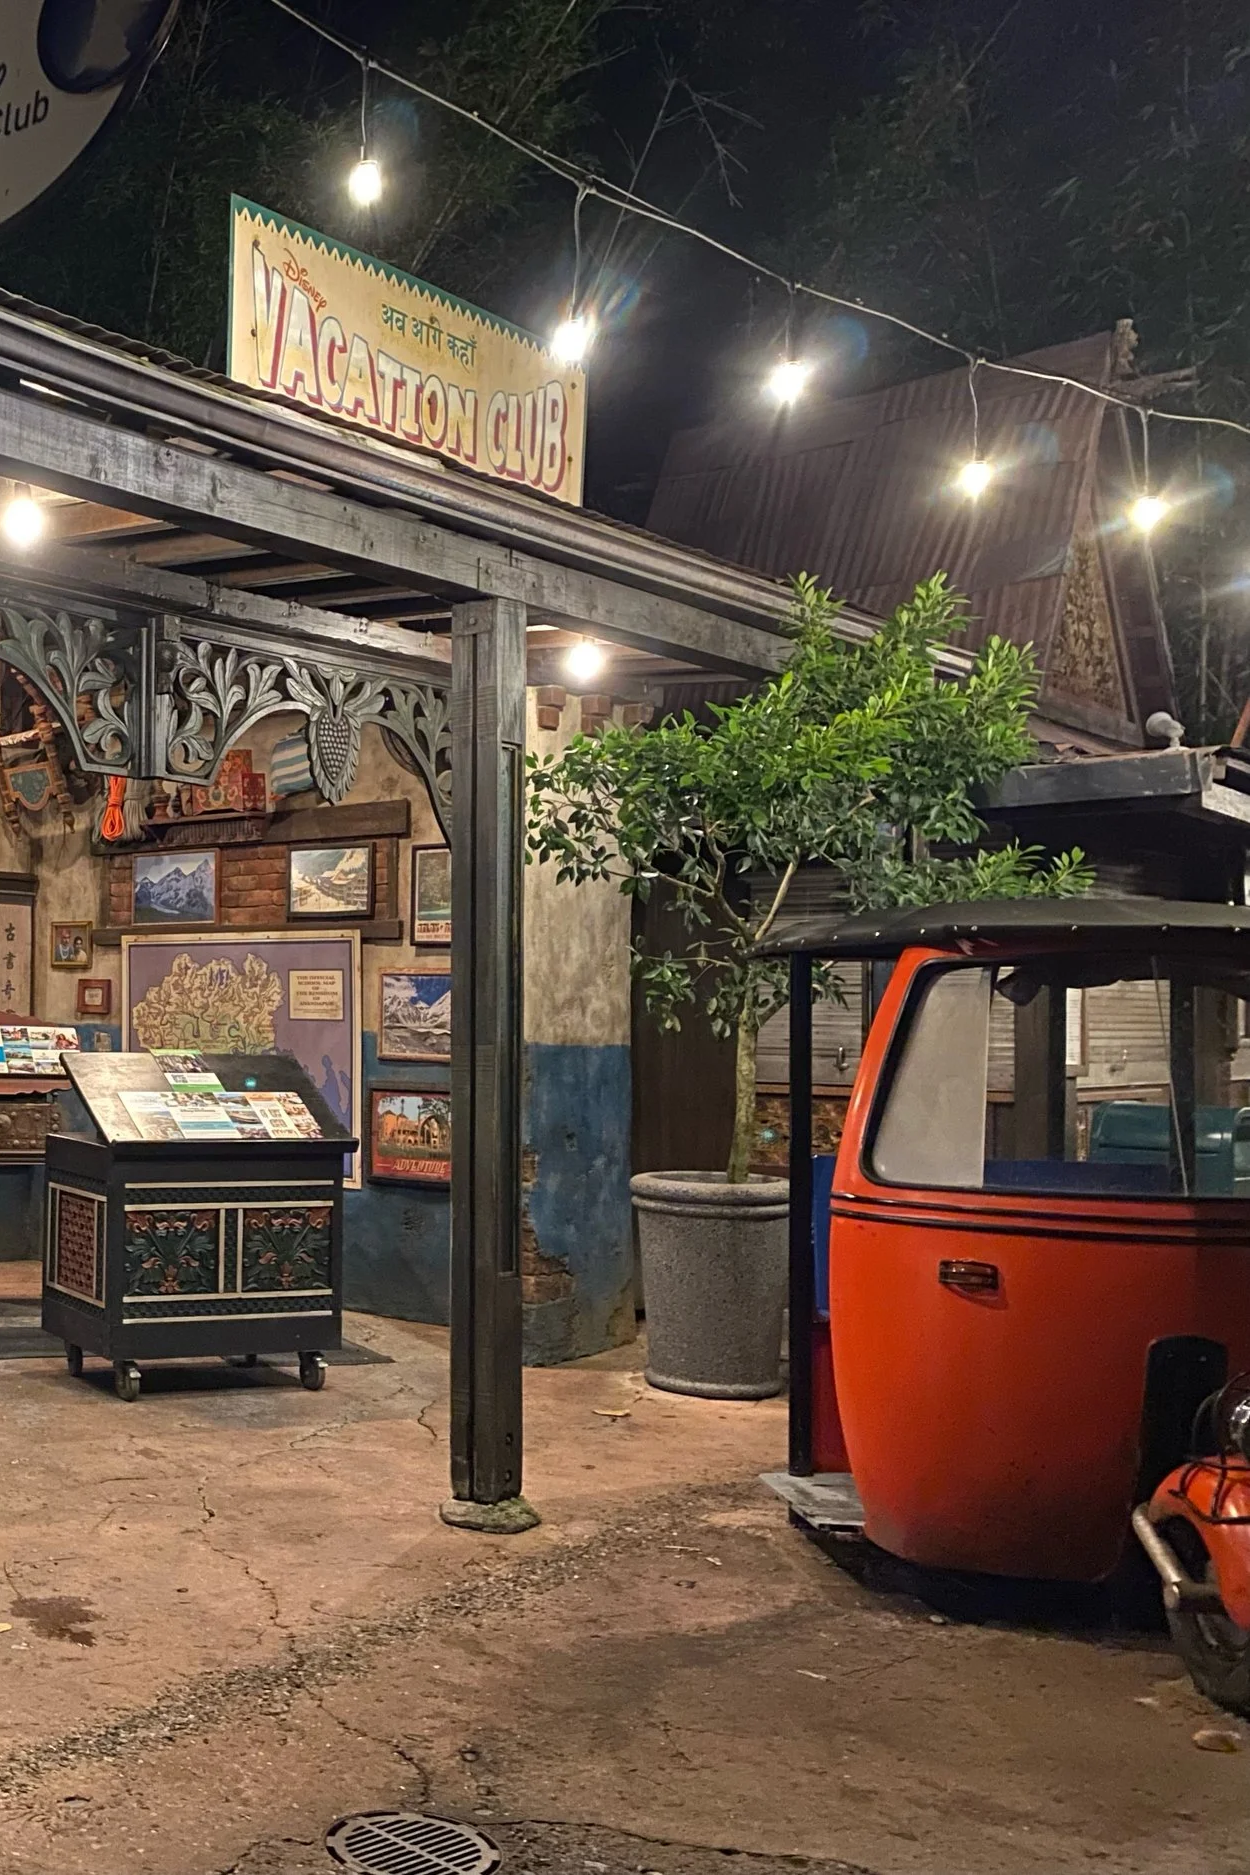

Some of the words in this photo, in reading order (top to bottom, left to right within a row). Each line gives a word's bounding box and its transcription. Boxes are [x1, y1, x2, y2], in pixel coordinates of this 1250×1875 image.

[252, 243, 479, 464] VACATION
[486, 378, 568, 493] CLUB
[393, 1159, 447, 1173] ADVENTURE
